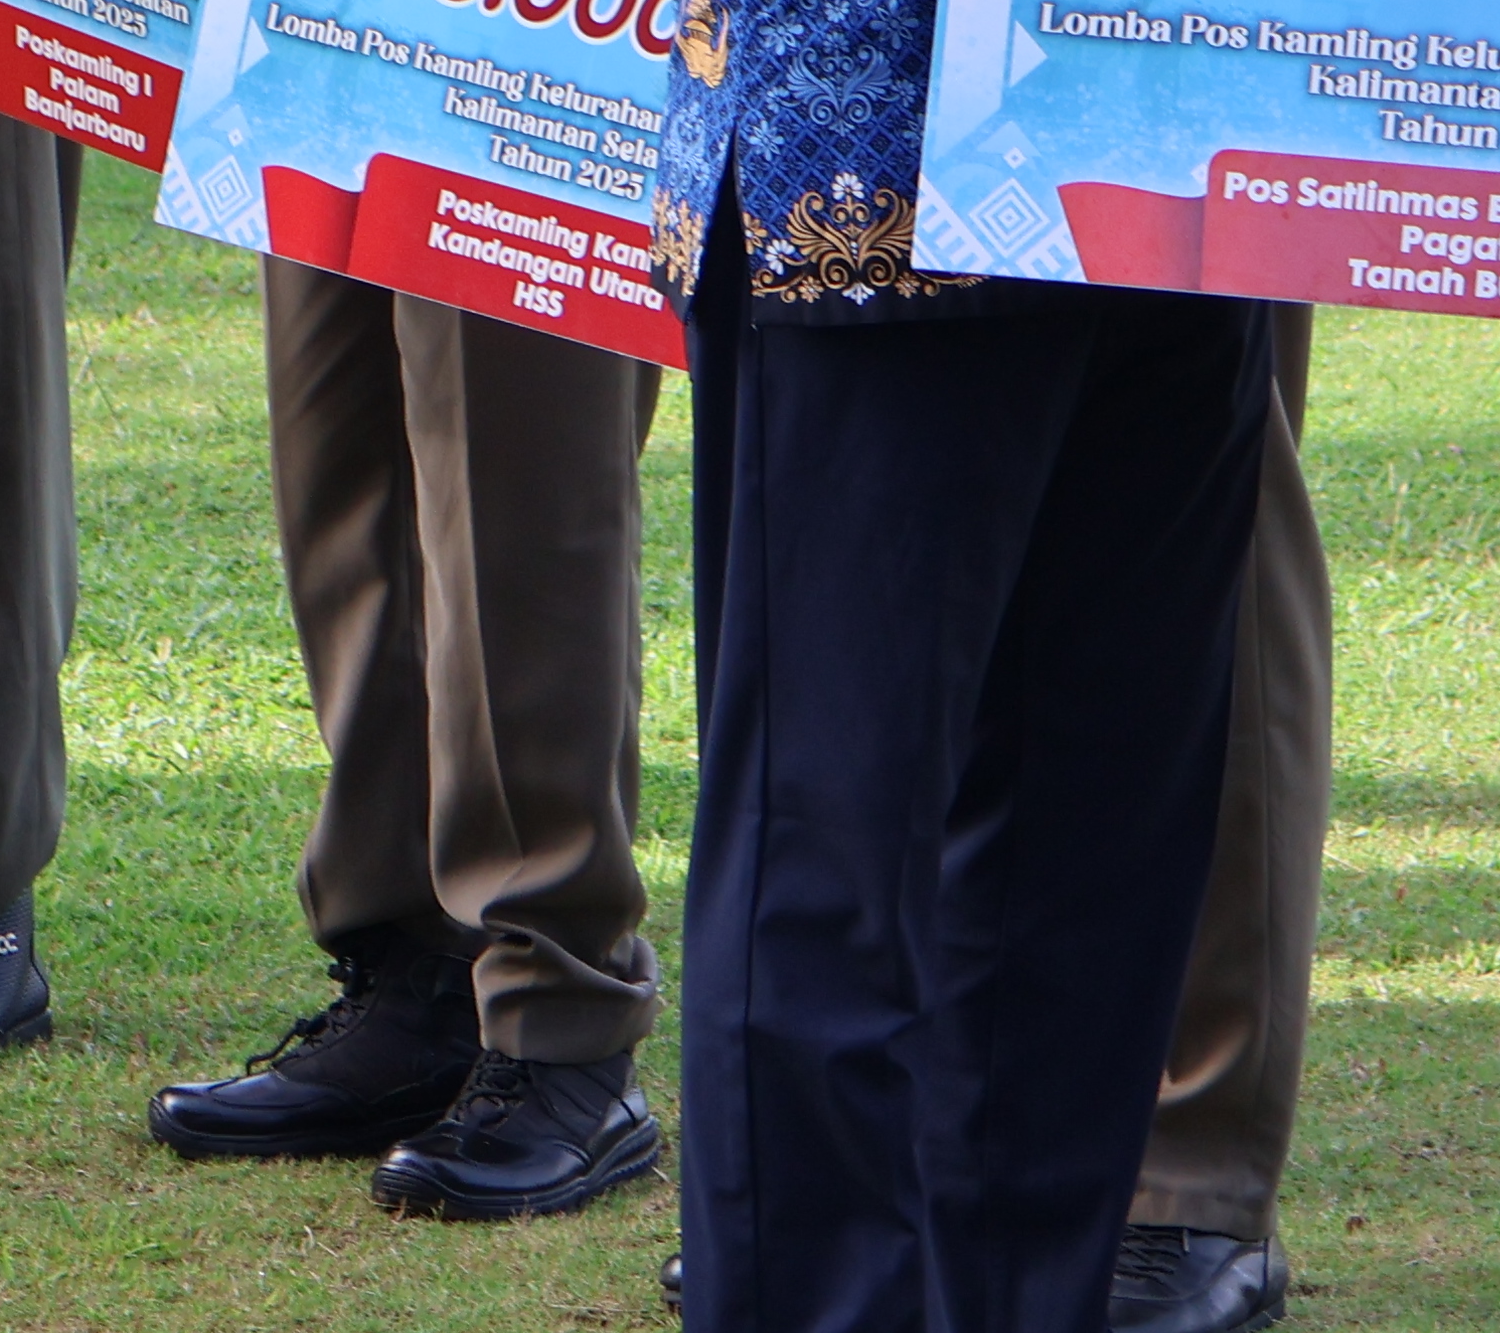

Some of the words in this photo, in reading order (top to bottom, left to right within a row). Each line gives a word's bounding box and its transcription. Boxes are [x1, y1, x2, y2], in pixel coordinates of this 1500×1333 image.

[91, 0, 149, 39] 2025
[266, 3, 356, 53] Lomba
[362, 27, 409, 66] Pos
[413, 42, 528, 101] Kamling
[1039, 2, 1172, 44] Lomba
[1181, 14, 1248, 49] Pos
[1257, 20, 1419, 70] Kamling
[14, 23, 142, 97] Poskamling
[48, 65, 121, 115] Palam
[23, 85, 148, 154] Banjarbaru
[443, 86, 598, 153] Kalimantan
[1379, 109, 1498, 150] Tahun
[488, 134, 573, 183] Tahun
[574, 157, 645, 202] 2025
[1224, 170, 1289, 206] Pos
[1297, 176, 1478, 223] Satlinmas
[437, 188, 590, 260] Poskamling
[428, 220, 586, 291] Kandangan
[588, 263, 665, 312] Utara
[513, 280, 565, 318] HSS
[1348, 257, 1465, 298] Tanah
